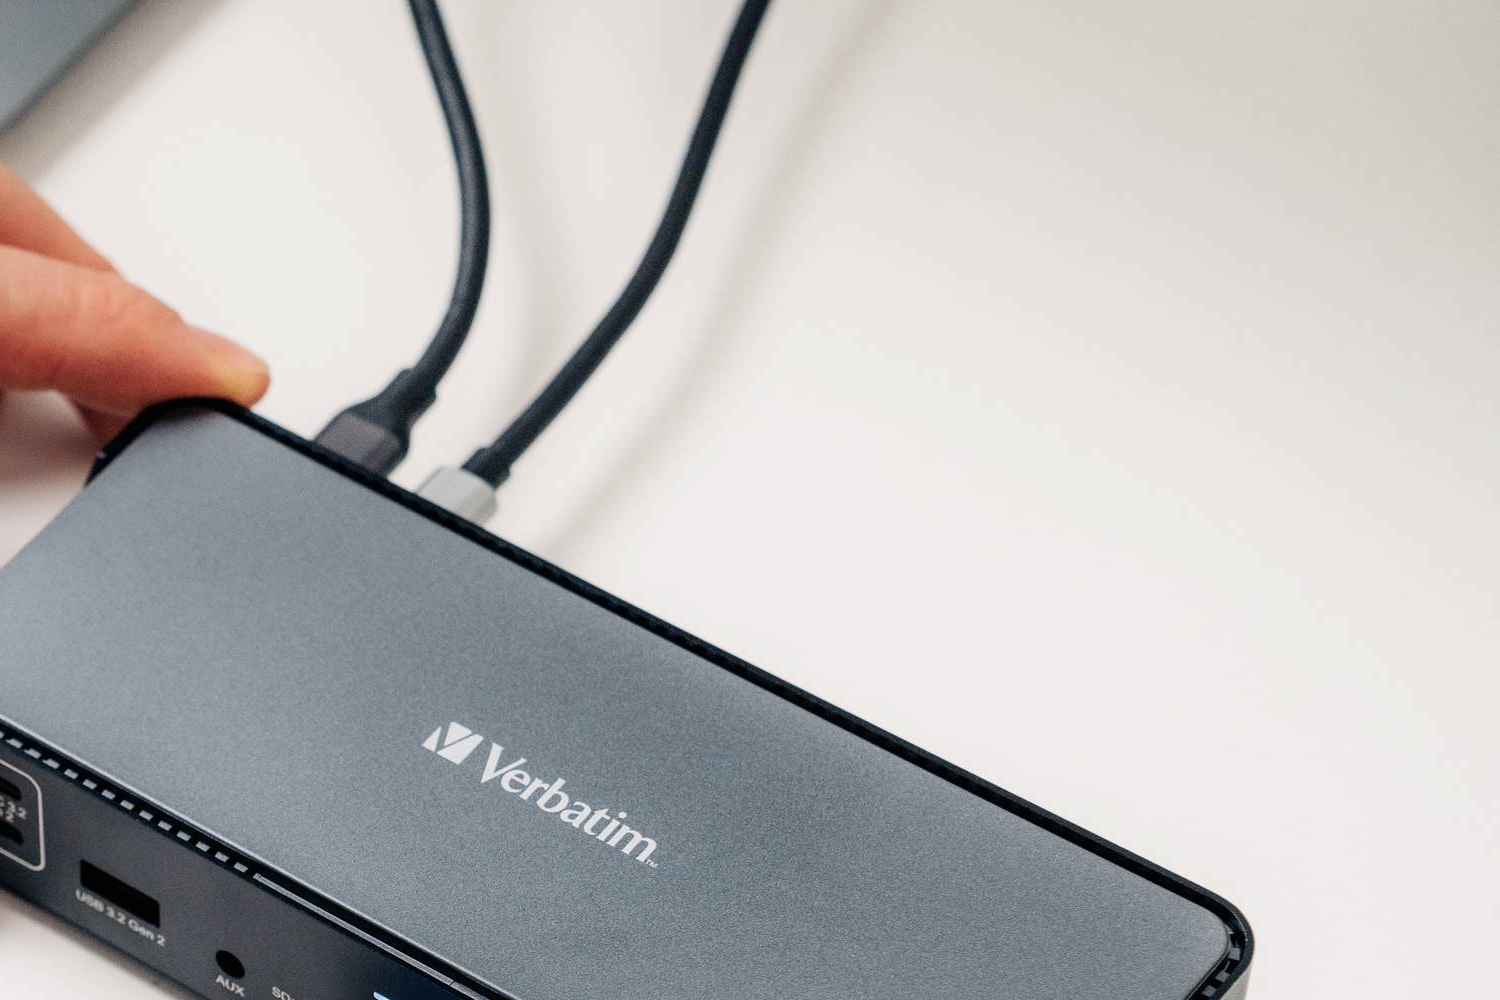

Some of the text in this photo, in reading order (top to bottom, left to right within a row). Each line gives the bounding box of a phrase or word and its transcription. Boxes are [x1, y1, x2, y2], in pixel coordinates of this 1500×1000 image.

[481, 742, 658, 863] Verbatim
[76, 889, 166, 947] USB 3.2 Gen 2
[215, 974, 245, 998] AUX
